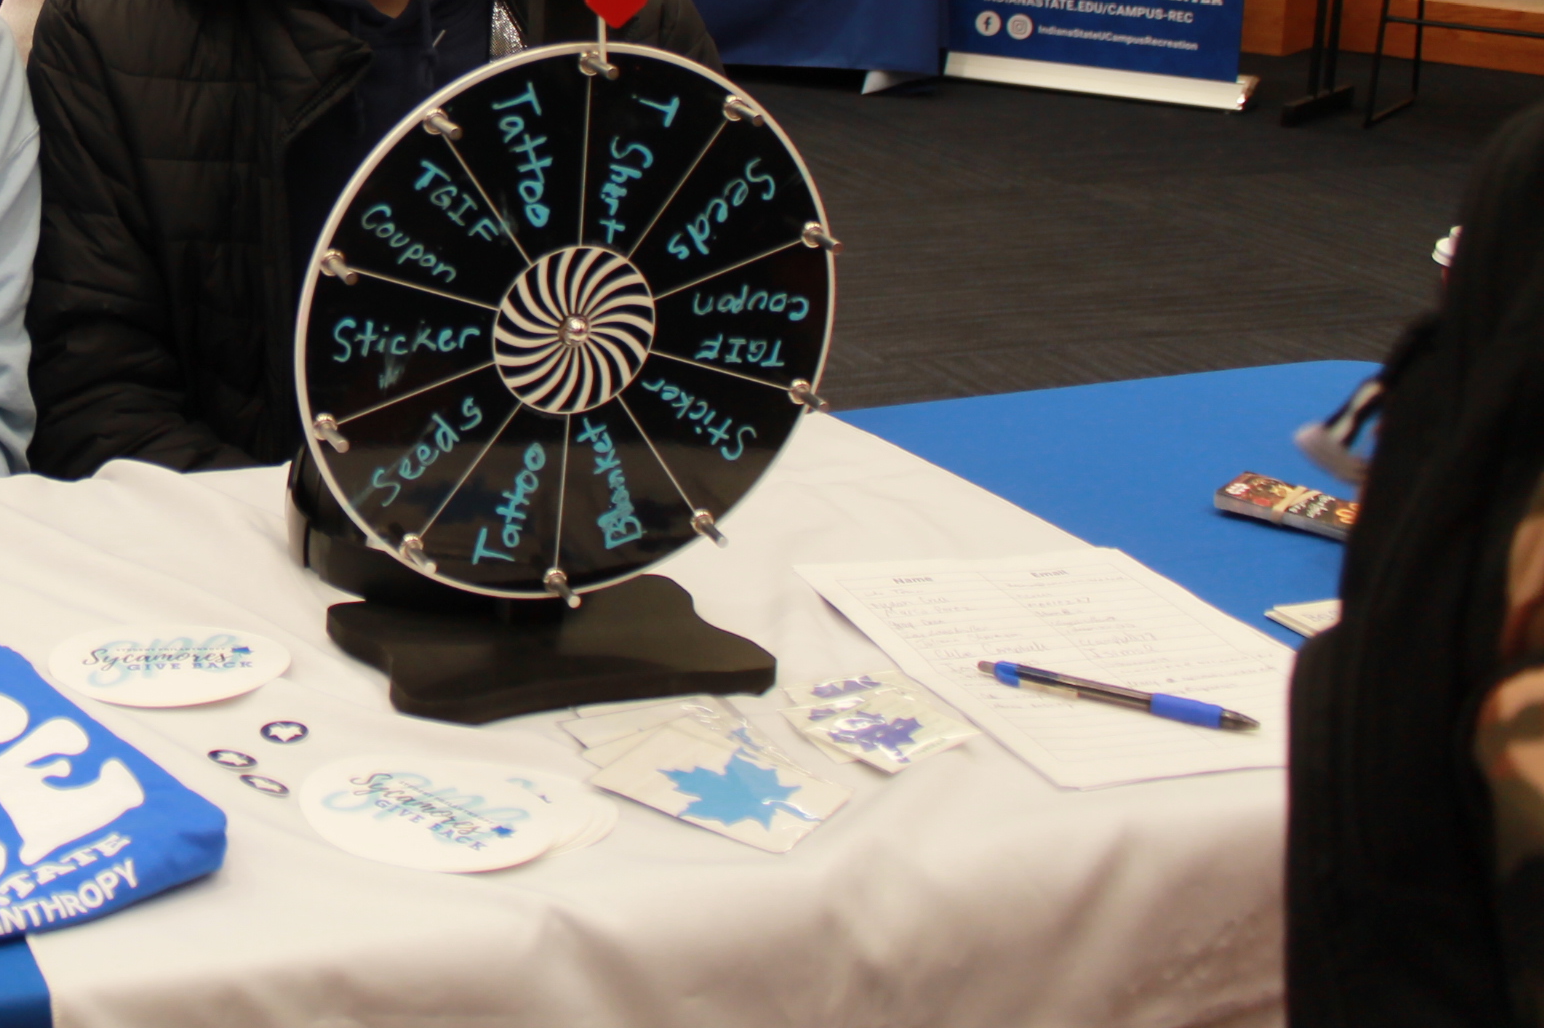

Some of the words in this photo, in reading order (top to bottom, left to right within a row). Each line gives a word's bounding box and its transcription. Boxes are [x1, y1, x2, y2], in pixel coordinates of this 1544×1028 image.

[631, 94, 680, 127] T
[492, 83, 553, 228] Tattoo
[414, 160, 501, 242] TGIF
[668, 158, 776, 261] Seeds
[361, 204, 457, 283] Coupon
[692, 284, 809, 321] Coupon
[333, 318, 481, 363] Sticker
[695, 334, 785, 368] TGIF
[641, 378, 756, 461] Sticker
[372, 398, 484, 506] Seeds
[472, 443, 546, 565] Tattoo
[893, 574, 934, 585] Name
[1030, 568, 1068, 580] Email
[82, 648, 233, 671] Sycamores
[126, 662, 181, 671] GIVE
[192, 661, 254, 670] BACK
[349, 772, 485, 835] Sycamores
[374, 798, 425, 824] GIVE
[427, 821, 488, 852] BACK
